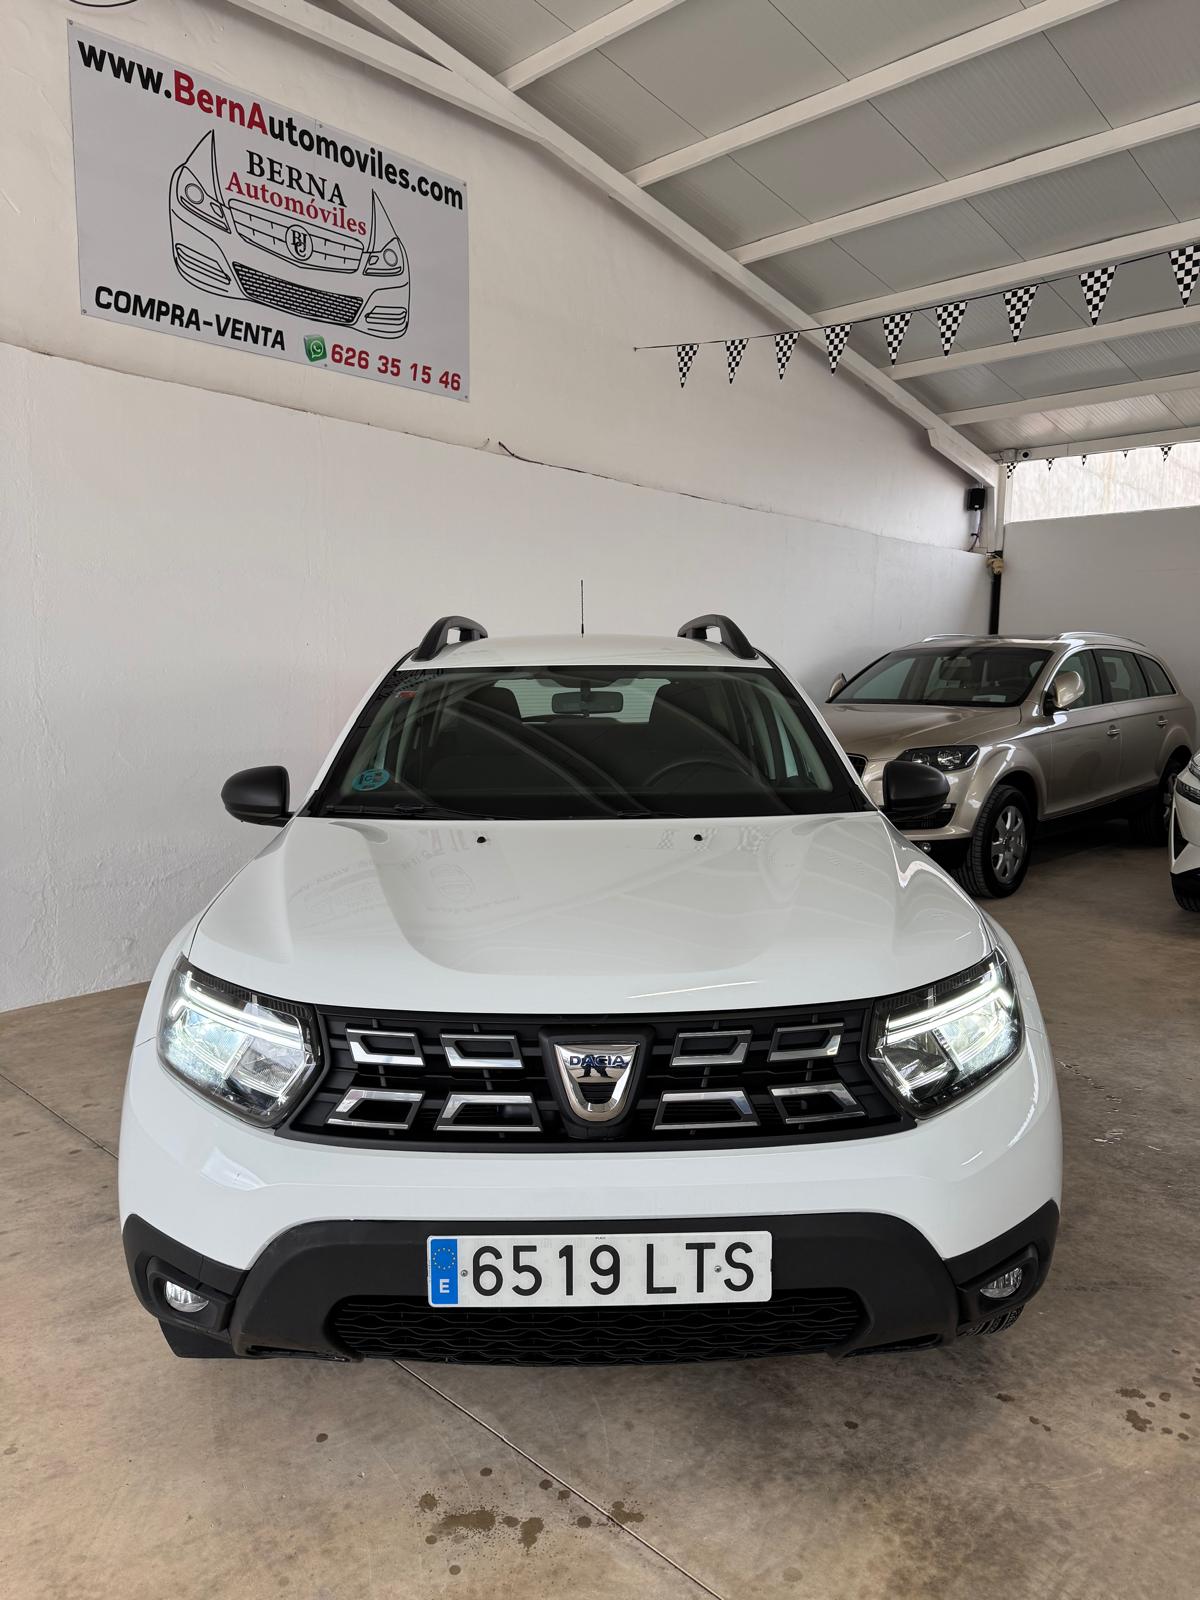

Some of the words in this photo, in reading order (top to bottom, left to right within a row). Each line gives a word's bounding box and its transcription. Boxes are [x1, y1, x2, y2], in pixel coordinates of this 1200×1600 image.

[77, 40, 464, 210] www.BernAutomoviles.com
[226, 170, 367, 236] Automóviles
[245, 149, 348, 208] BERNA
[95, 285, 286, 351] COMPRA-VENTA
[330, 343, 370, 370] 626
[377, 355, 401, 377] 35
[410, 363, 432, 385] 15
[438, 370, 461, 392] 46
[569, 1055, 626, 1066] DACIA
[439, 1278, 450, 1294] E
[472, 1245, 621, 1296] 6519
[646, 1241, 754, 1295] LTS
